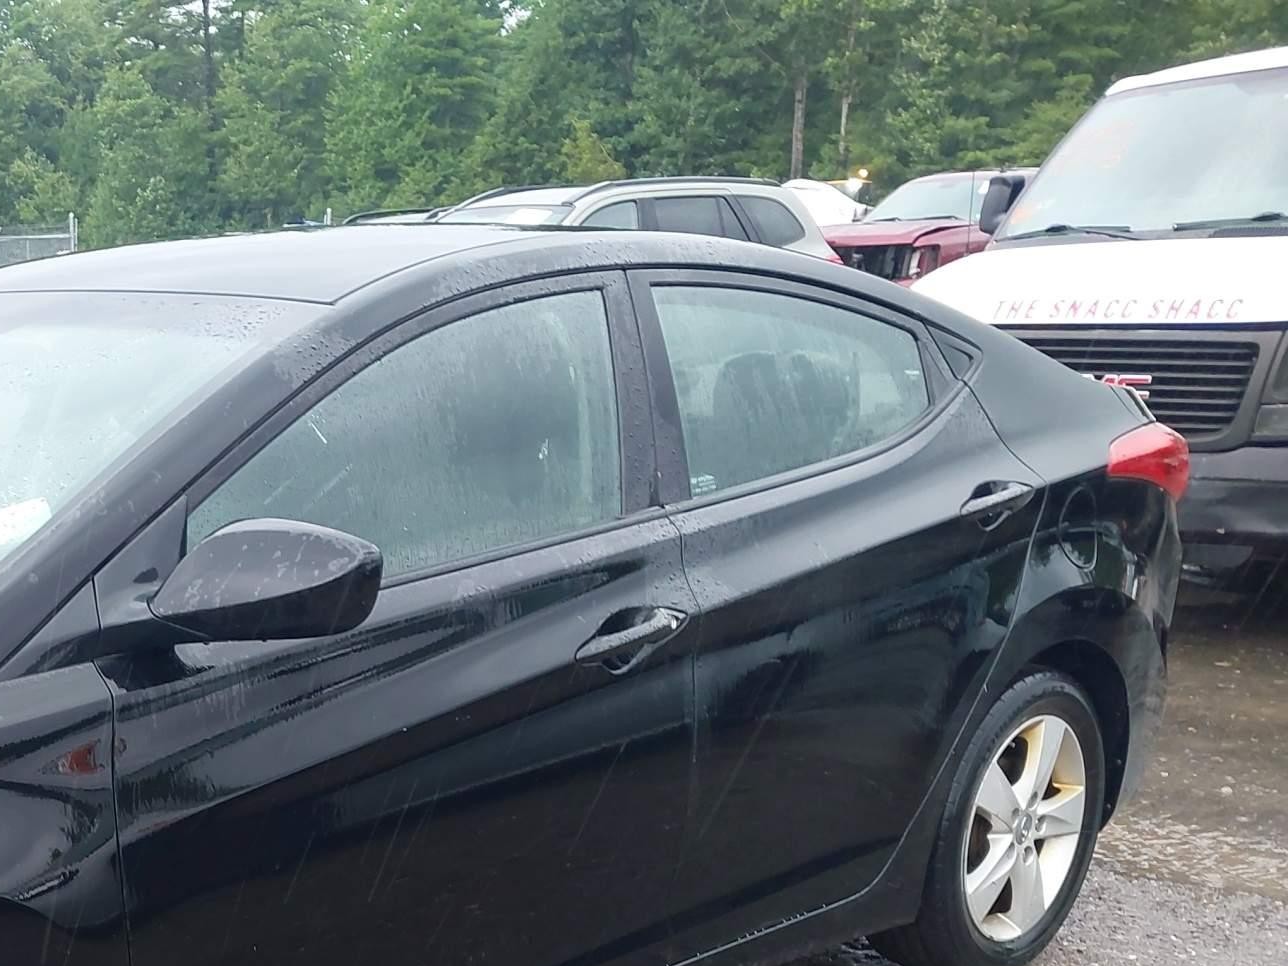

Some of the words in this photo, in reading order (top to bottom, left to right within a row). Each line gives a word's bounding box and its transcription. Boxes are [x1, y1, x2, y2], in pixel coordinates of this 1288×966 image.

[993, 299, 1039, 320] THE
[1049, 298, 1138, 319] SNACC
[1147, 298, 1244, 320] SHACC
